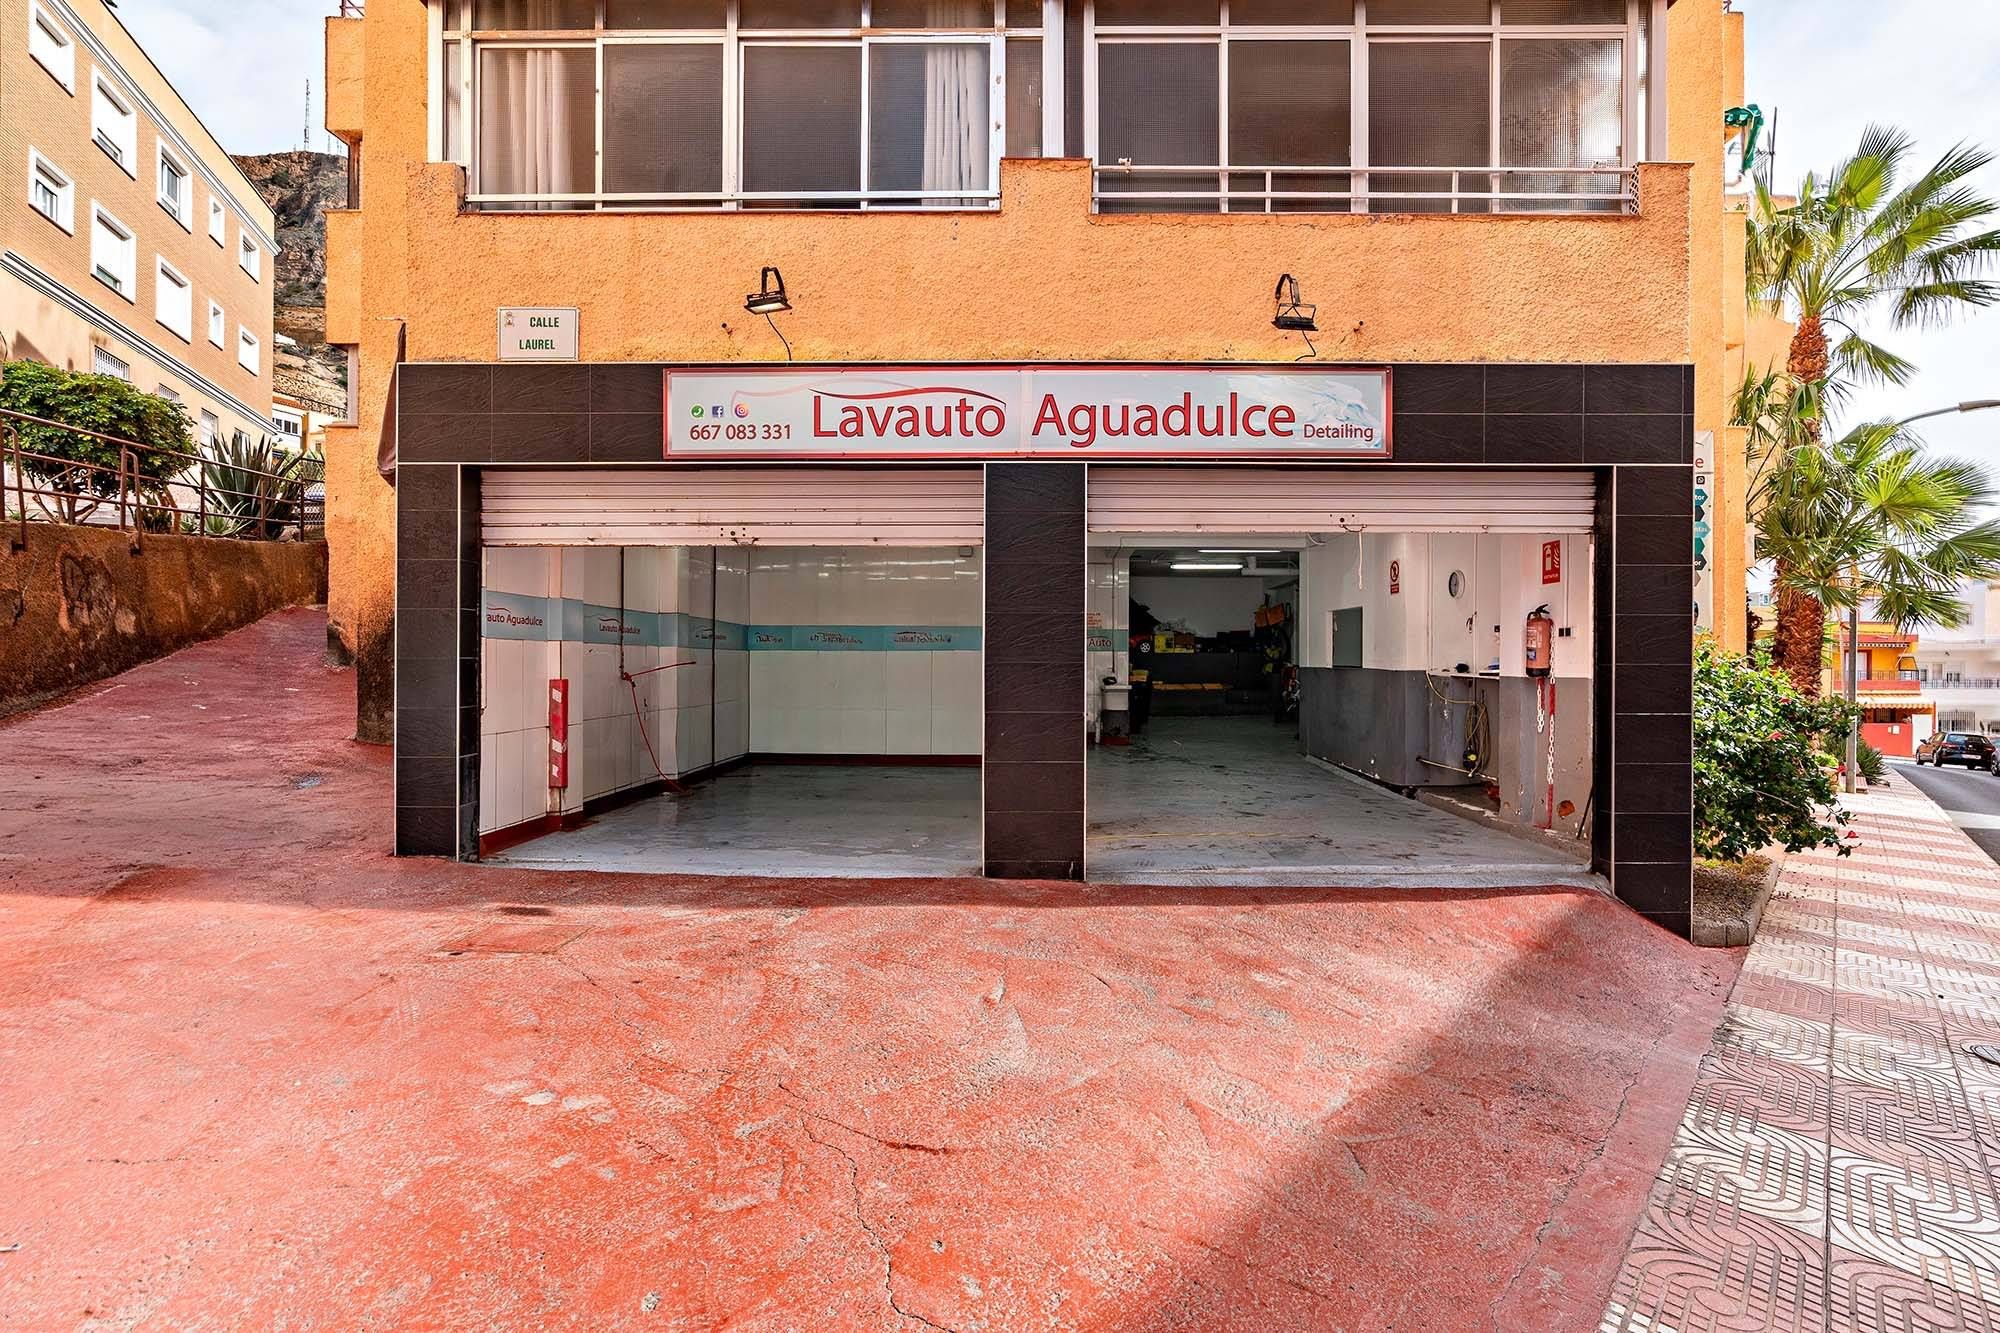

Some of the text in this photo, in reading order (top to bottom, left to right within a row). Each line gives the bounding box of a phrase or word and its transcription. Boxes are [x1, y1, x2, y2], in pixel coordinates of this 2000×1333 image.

[529, 316, 560, 328] CALLE
[519, 339, 556, 350] LAUREL
[812, 392, 1374, 448] Lavauto Aguadulce Detailing
[689, 424, 792, 441] 667 083 331
[506, 614, 544, 627] Aguadulce
[599, 623, 618, 633] Lavauto
[1088, 638, 1112, 647] Auto
